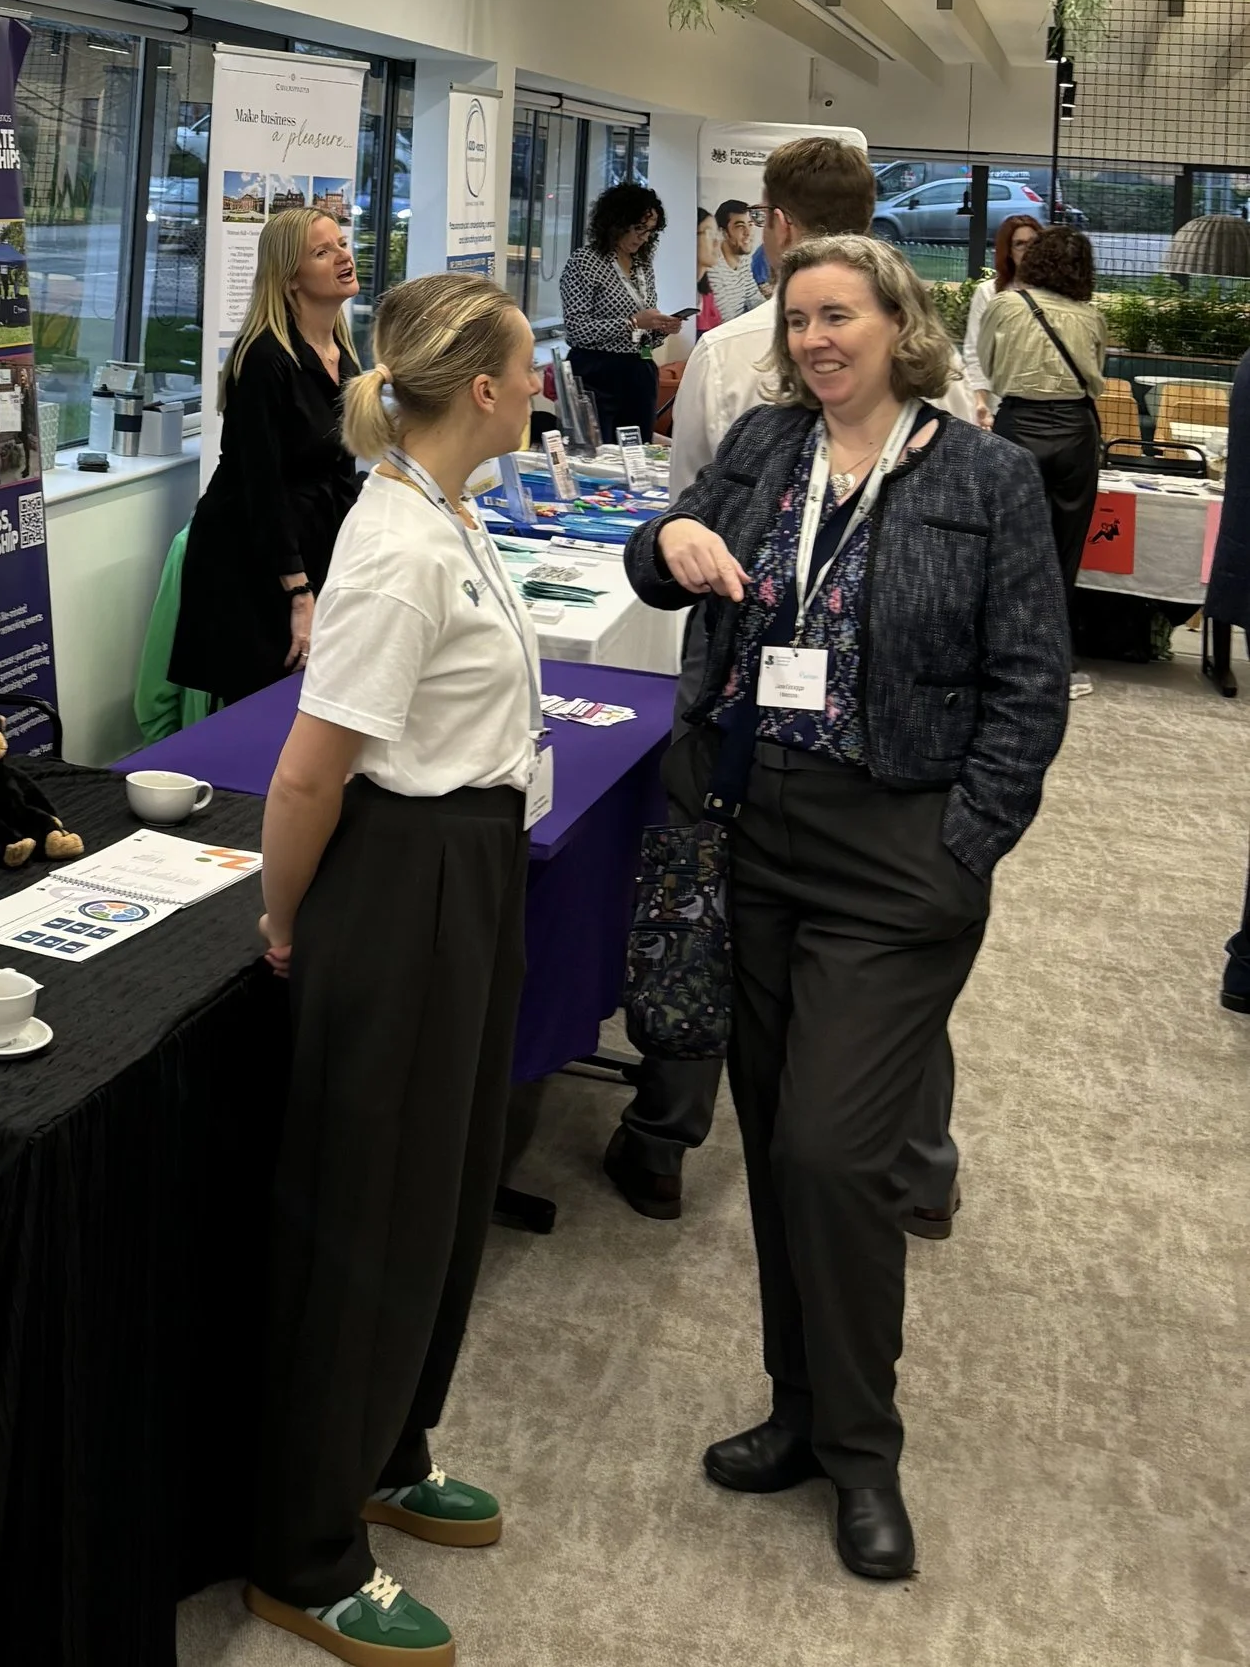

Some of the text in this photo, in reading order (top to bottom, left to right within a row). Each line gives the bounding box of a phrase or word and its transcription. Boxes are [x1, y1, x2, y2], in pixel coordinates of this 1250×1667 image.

[236, 108, 296, 127] Make business
[272, 131, 282, 142] a
